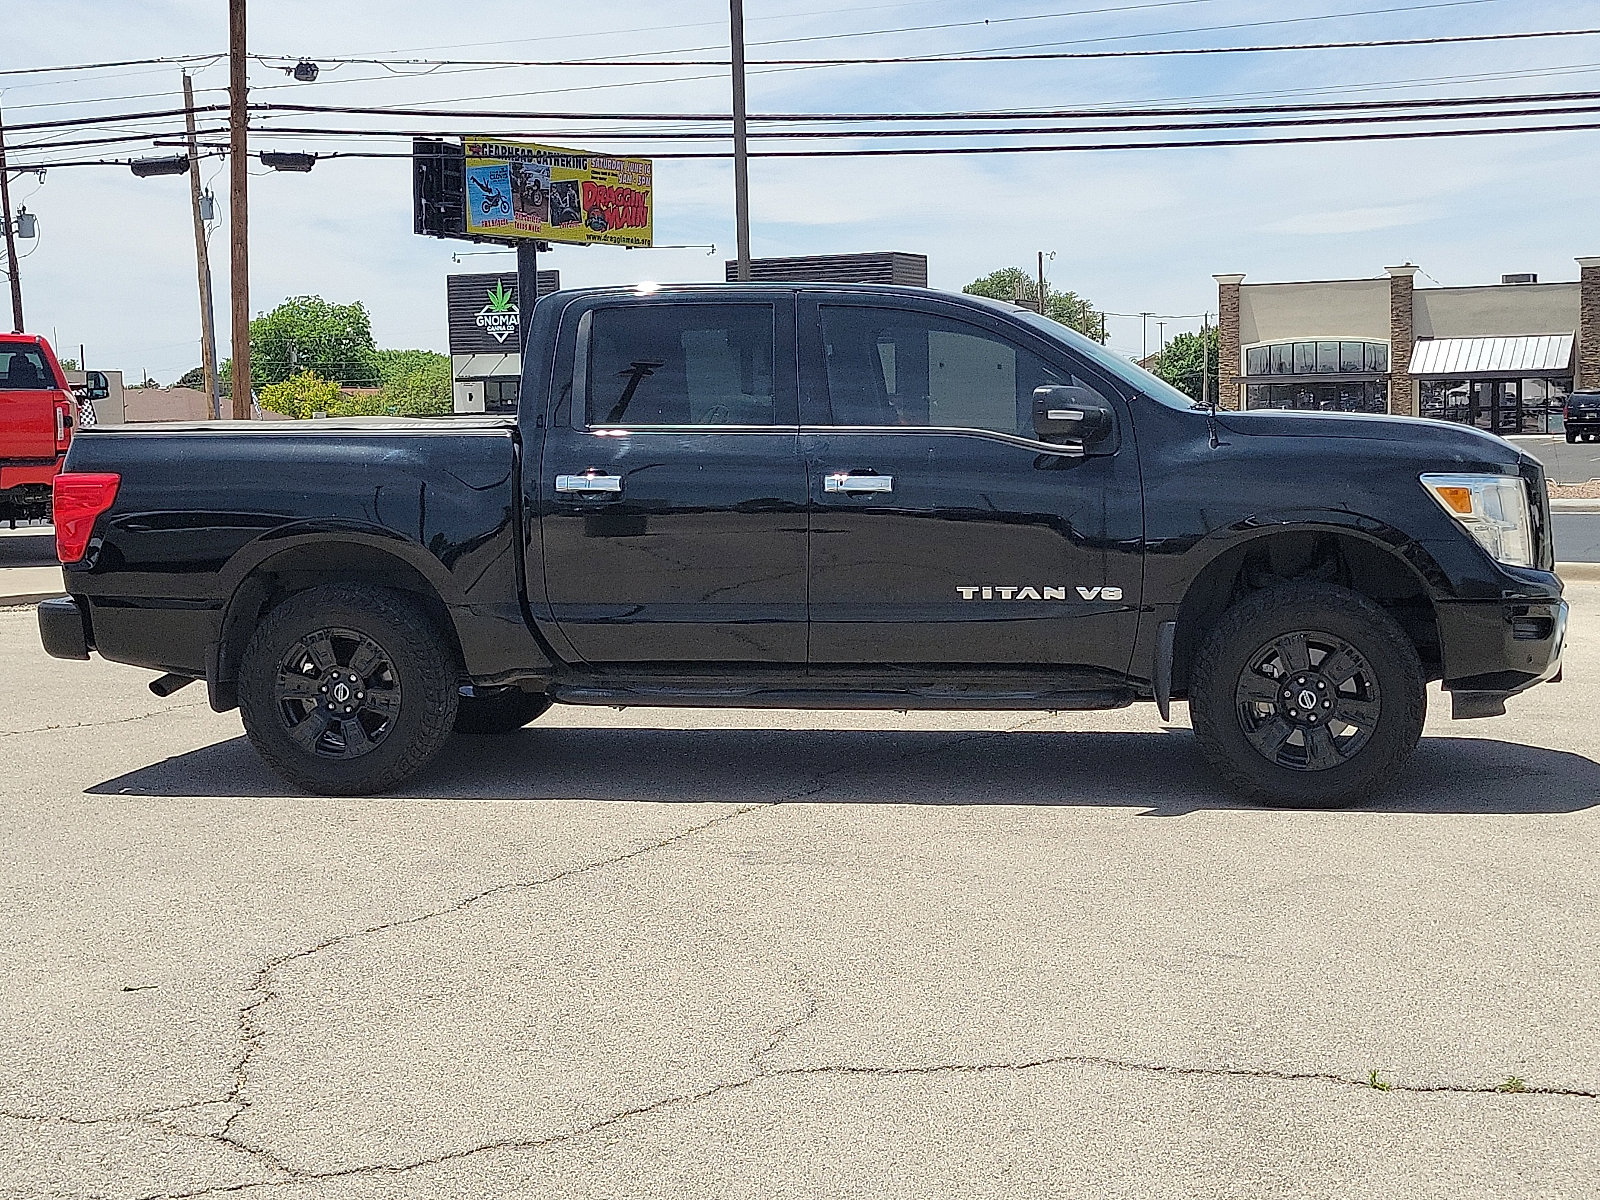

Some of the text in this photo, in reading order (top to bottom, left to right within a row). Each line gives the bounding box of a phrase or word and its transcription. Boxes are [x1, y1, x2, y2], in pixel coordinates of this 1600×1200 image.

[604, 204, 648, 231] MAIN
[956, 586, 1123, 600] TITAN V8
